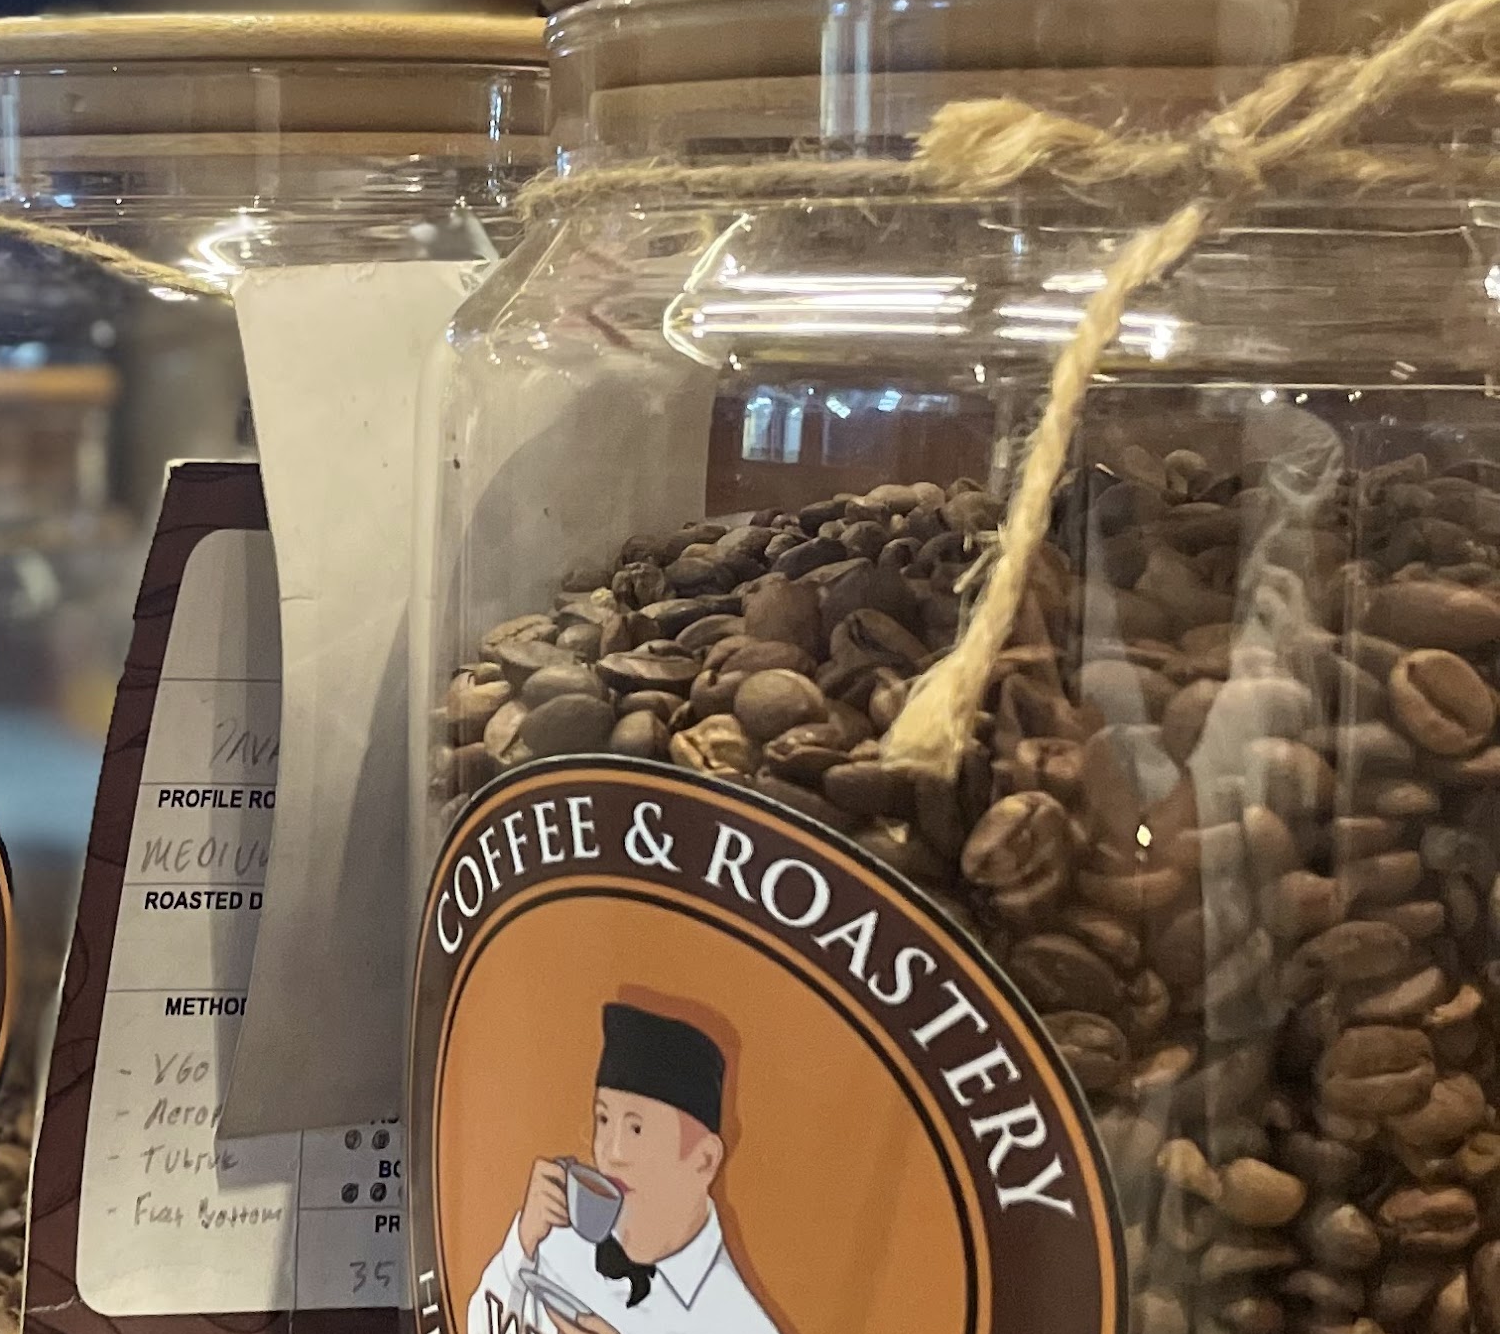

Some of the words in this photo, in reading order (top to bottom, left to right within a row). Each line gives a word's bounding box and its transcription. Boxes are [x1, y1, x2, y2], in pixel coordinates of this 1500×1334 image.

[157, 789, 244, 809] PROFILE
[144, 891, 243, 910] ROASTED
[435, 796, 601, 955] COFFEE
[624, 801, 682, 871] &
[704, 822, 1076, 1219] ROASTERY
